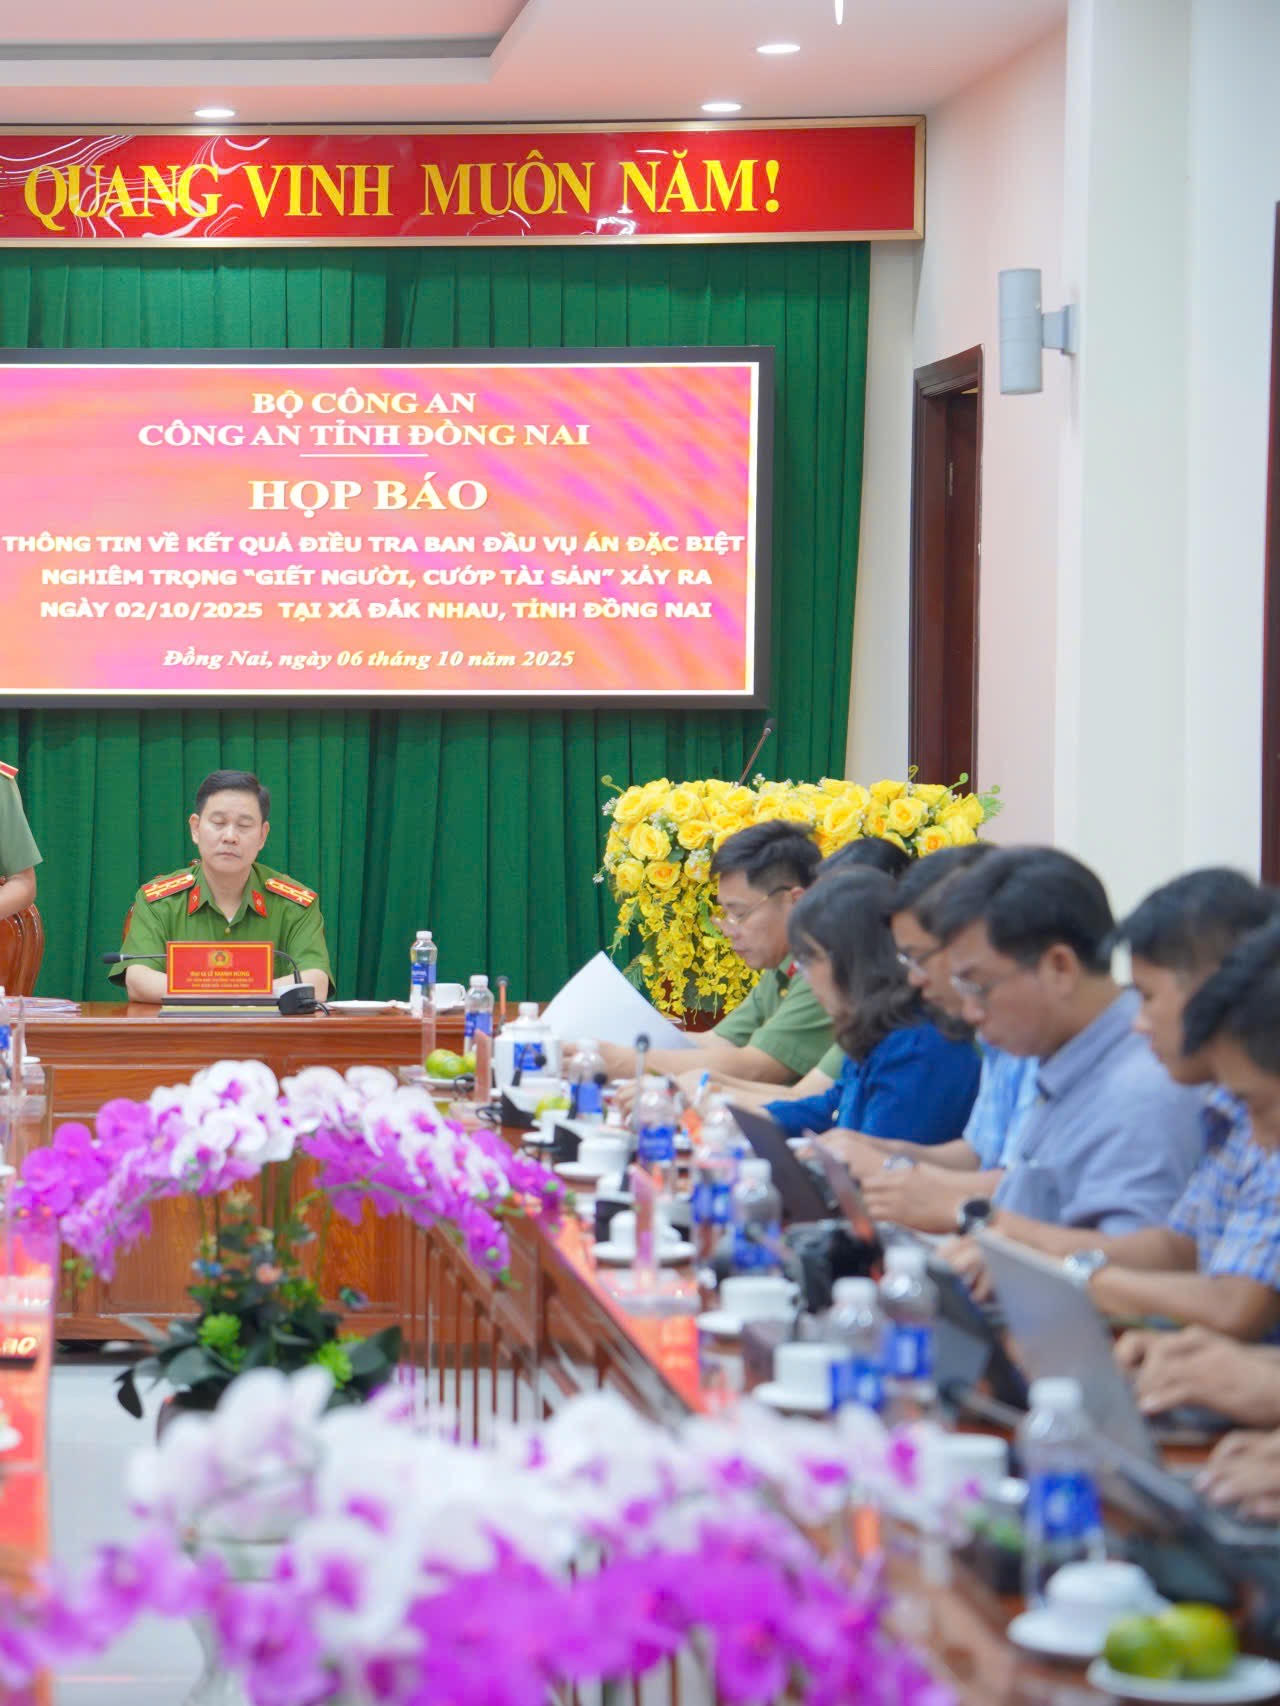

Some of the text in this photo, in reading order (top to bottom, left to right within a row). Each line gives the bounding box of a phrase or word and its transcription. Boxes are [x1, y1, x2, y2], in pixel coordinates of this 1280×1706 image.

[23, 164, 221, 231] QUANG
[241, 163, 392, 217] VINH
[420, 148, 595, 215] MUÔN
[619, 149, 780, 213] NĂM!
[251, 387, 477, 419] BỘ CÔNG AN
[137, 419, 591, 447] CÔNG AN TỈNH ĐỒNG NAI
[247, 471, 488, 519] HỌP BÁO
[2, 532, 746, 557] THÔNG TIN VỀ KẾT QUẢ ĐIỀU TRA BAN ĐẦU VỤ ÁN ĐẶC BIỆT
[41, 565, 145, 587] NGHIÊM
[148, 568, 238, 589] TRỌNG
[321, 565, 418, 589] NGƯỜI,
[423, 565, 497, 587] CƯỚP
[500, 565, 545, 587] TÀI
[620, 565, 672, 587] XẢY
[677, 568, 714, 586] RA
[40, 598, 110, 619] NGÀY
[114, 602, 264, 621] 02/10/2025
[278, 602, 323, 622] TẠI
[328, 598, 363, 619] XÃ
[426, 602, 507, 621] NHAU,
[511, 598, 577, 619] TỈNH
[582, 598, 659, 619] ĐỒNG
[664, 602, 714, 619] NAI
[162, 647, 577, 671] Đồng Nai, ngày 06 tháng 10 năm 2025
